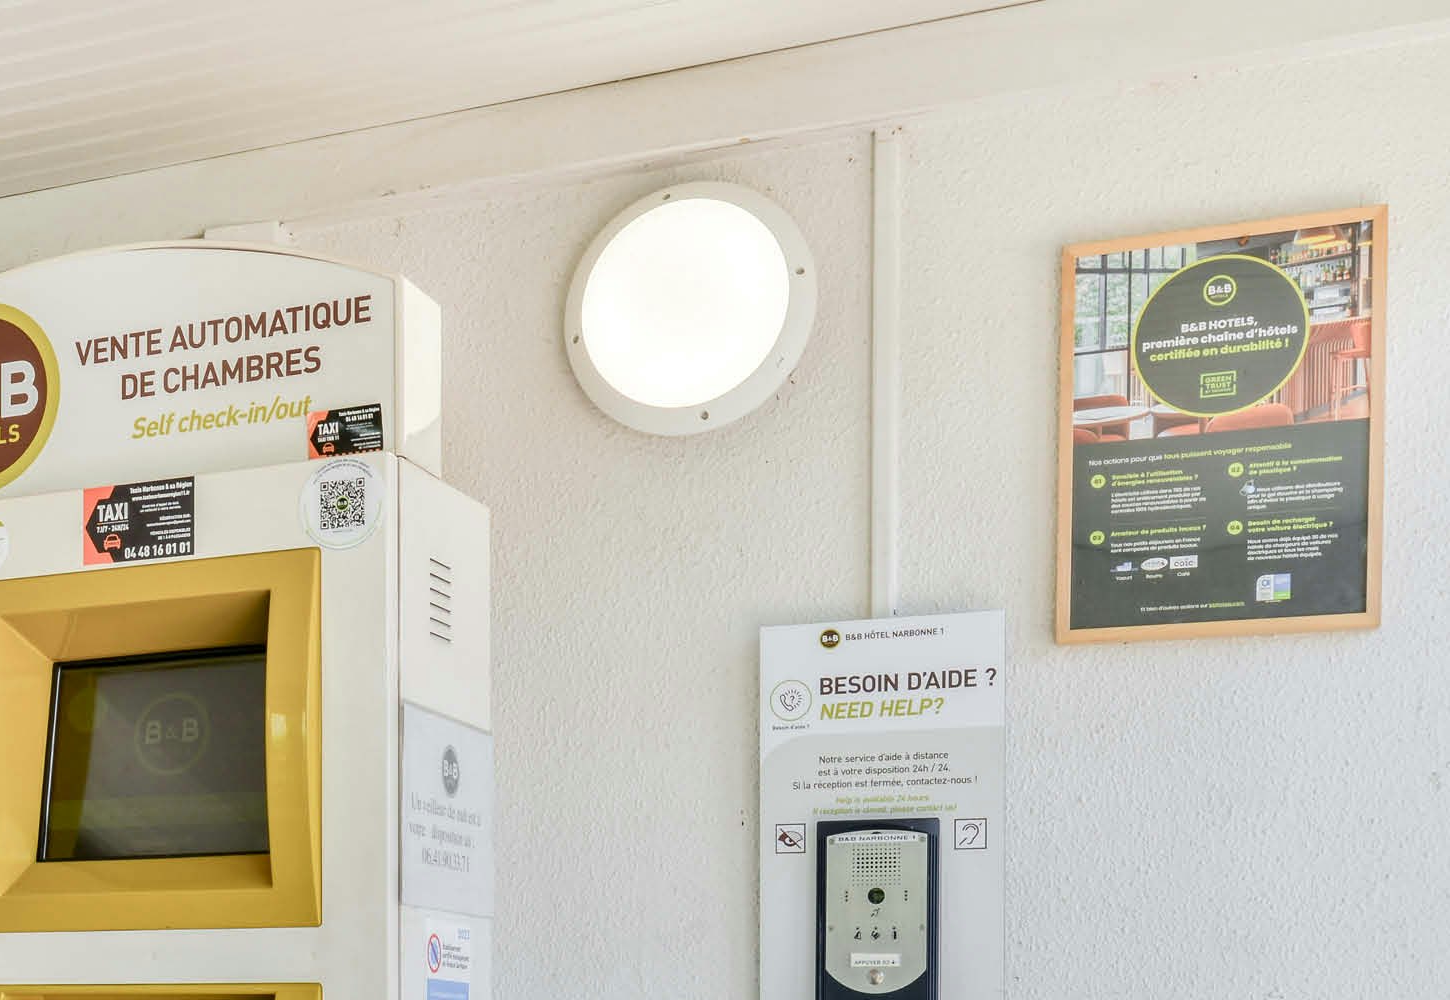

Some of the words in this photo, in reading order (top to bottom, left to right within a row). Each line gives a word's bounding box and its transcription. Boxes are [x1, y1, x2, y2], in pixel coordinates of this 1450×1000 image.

[1208, 283, 1232, 294] B&B
[75, 328, 163, 366] VENTE
[168, 294, 372, 353] AUTOMATIQUE
[1181, 323, 1207, 334] B&B
[1208, 316, 1258, 330] HOTELS,
[1142, 336, 1199, 352] première
[1200, 331, 1244, 345] chaîne
[1150, 348, 1201, 362] certifiée
[1202, 347, 1218, 357] en
[1220, 341, 1283, 355] durabilité
[121, 370, 156, 400] DE
[163, 346, 322, 395] CHAMBRES
[131, 414, 175, 440] Self
[177, 395, 312, 433] check-in/out
[318, 422, 339, 436] TAXI
[96, 502, 129, 522] TAXI
[124, 546, 137, 559] 04
[137, 545, 150, 557] 48
[152, 544, 164, 556] 16
[165, 542, 177, 554] 01
[179, 541, 190, 553] 01
[845, 633, 862, 641] B&B
[864, 630, 891, 640] HÔTEL
[892, 628, 938, 638] NARBONNE
[940, 627, 944, 636] 1
[819, 672, 899, 696] BESOIN
[908, 669, 978, 691] D'AIDE
[985, 667, 997, 686] ?
[820, 701, 874, 720] NEED
[879, 697, 944, 717] HELP?
[819, 755, 842, 764] Notre
[844, 754, 876, 763] service
[878, 753, 902, 762] d'aide
[905, 753, 910, 761] à
[912, 751, 949, 760] distance
[818, 768, 831, 776] est
[833, 767, 839, 776] à
[841, 767, 863, 775] votre
[864, 766, 910, 776] disposition
[912, 764, 929, 773] 24h
[930, 763, 935, 773] /
[792, 781, 801, 790] Si
[803, 780, 811, 790] la
[813, 779, 852, 790] réception
[855, 779, 868, 788] est
[870, 778, 904, 788] fermée,
[906, 776, 972, 786] contactez-nous
